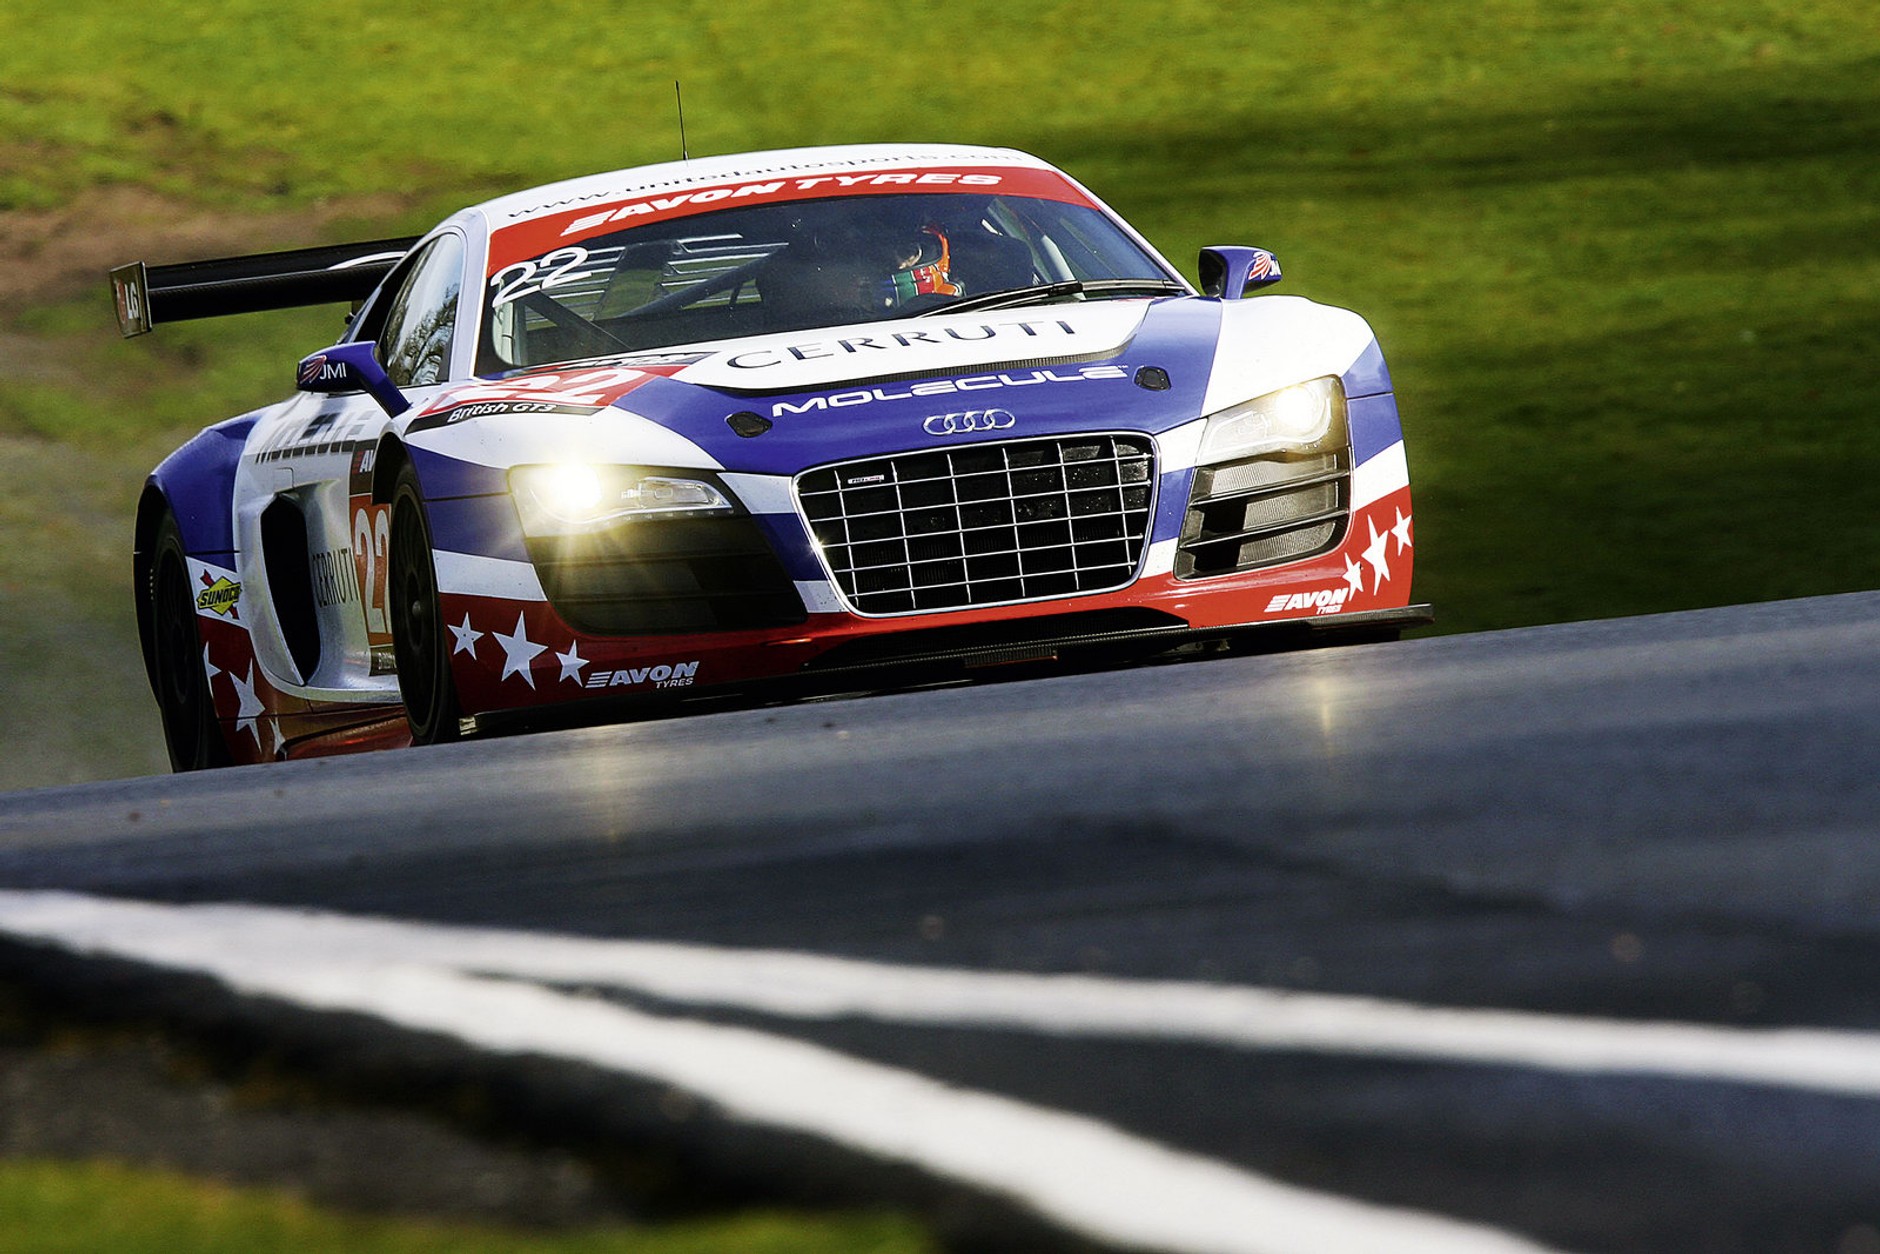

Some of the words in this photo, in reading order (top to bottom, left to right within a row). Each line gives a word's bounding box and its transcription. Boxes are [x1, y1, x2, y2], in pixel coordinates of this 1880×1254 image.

[608, 180, 787, 224] AVON
[796, 172, 1002, 190] TYRES
[490, 246, 592, 308] 22
[725, 319, 1076, 370] CERRUTI
[319, 361, 348, 380] JMI
[772, 364, 1129, 418] MOLECULE
[447, 402, 509, 423] British
[512, 402, 557, 413] GT3
[354, 507, 393, 634] 22
[200, 585, 241, 606] SUNOCO
[1284, 587, 1350, 611] AVON
[1316, 603, 1344, 616] TYRES
[608, 660, 700, 686] AVON
[655, 676, 694, 689] TYRES
